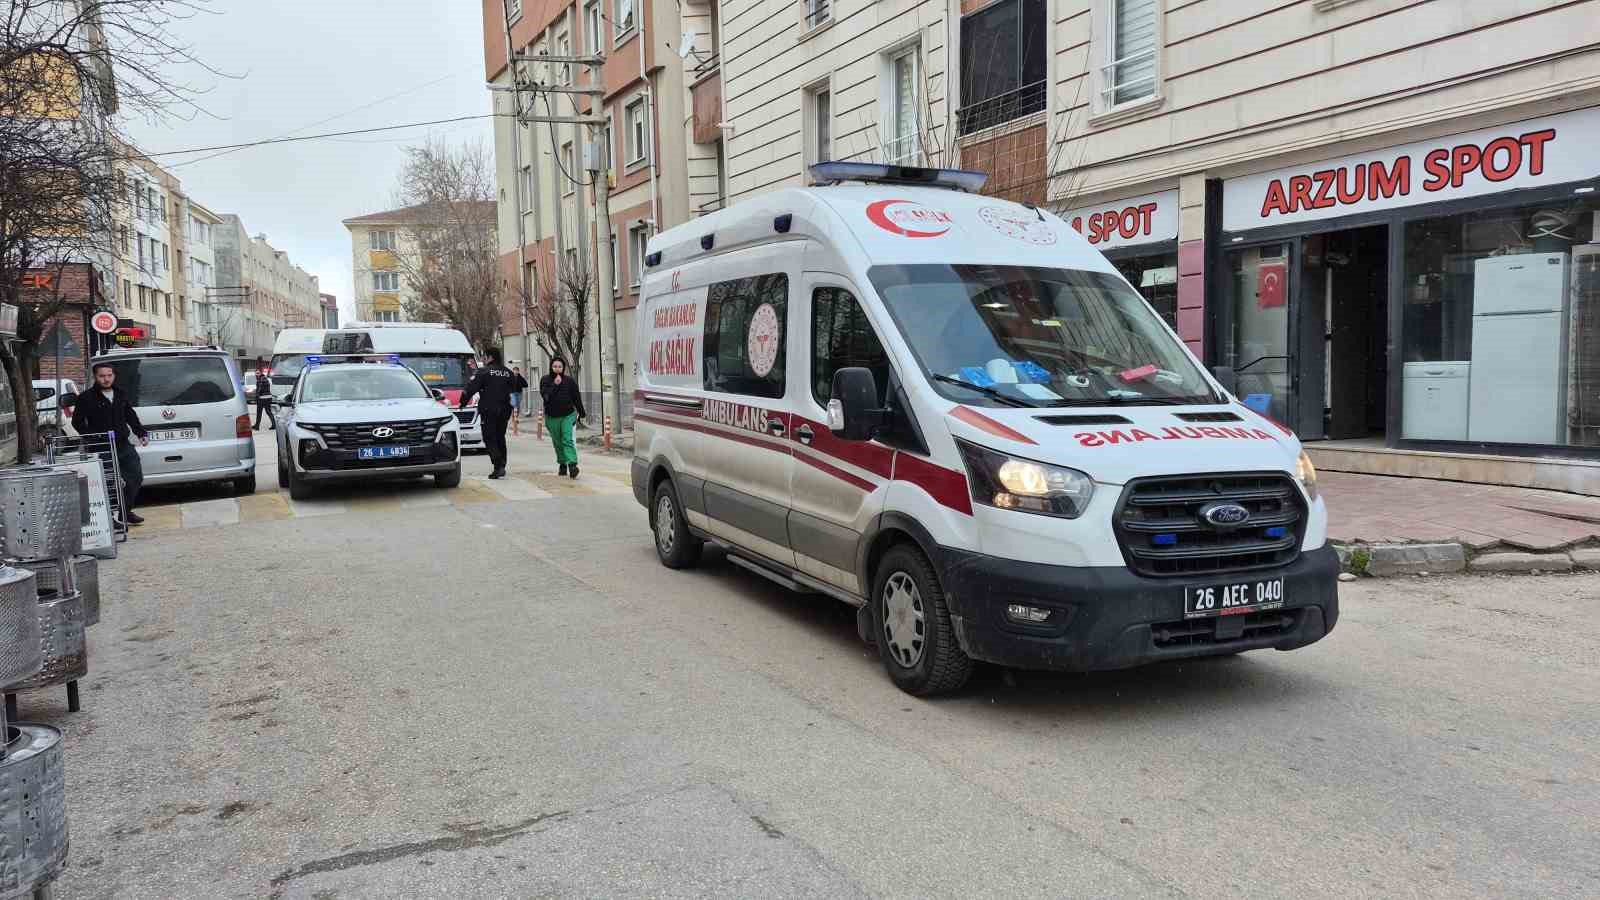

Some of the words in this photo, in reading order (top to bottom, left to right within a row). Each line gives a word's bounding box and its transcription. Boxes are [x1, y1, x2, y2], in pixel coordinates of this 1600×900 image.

[1261, 156, 1411, 217] ARZUM
[1423, 128, 1556, 192] SPOT
[1088, 202, 1157, 244] SPOT
[666, 333, 695, 375] SAĞLIK
[703, 399, 769, 433] AMBULANS
[363, 447, 373, 457] 26
[1195, 587, 1215, 610] 26
[1222, 583, 1249, 607] AEC
[1256, 580, 1281, 602] 040
